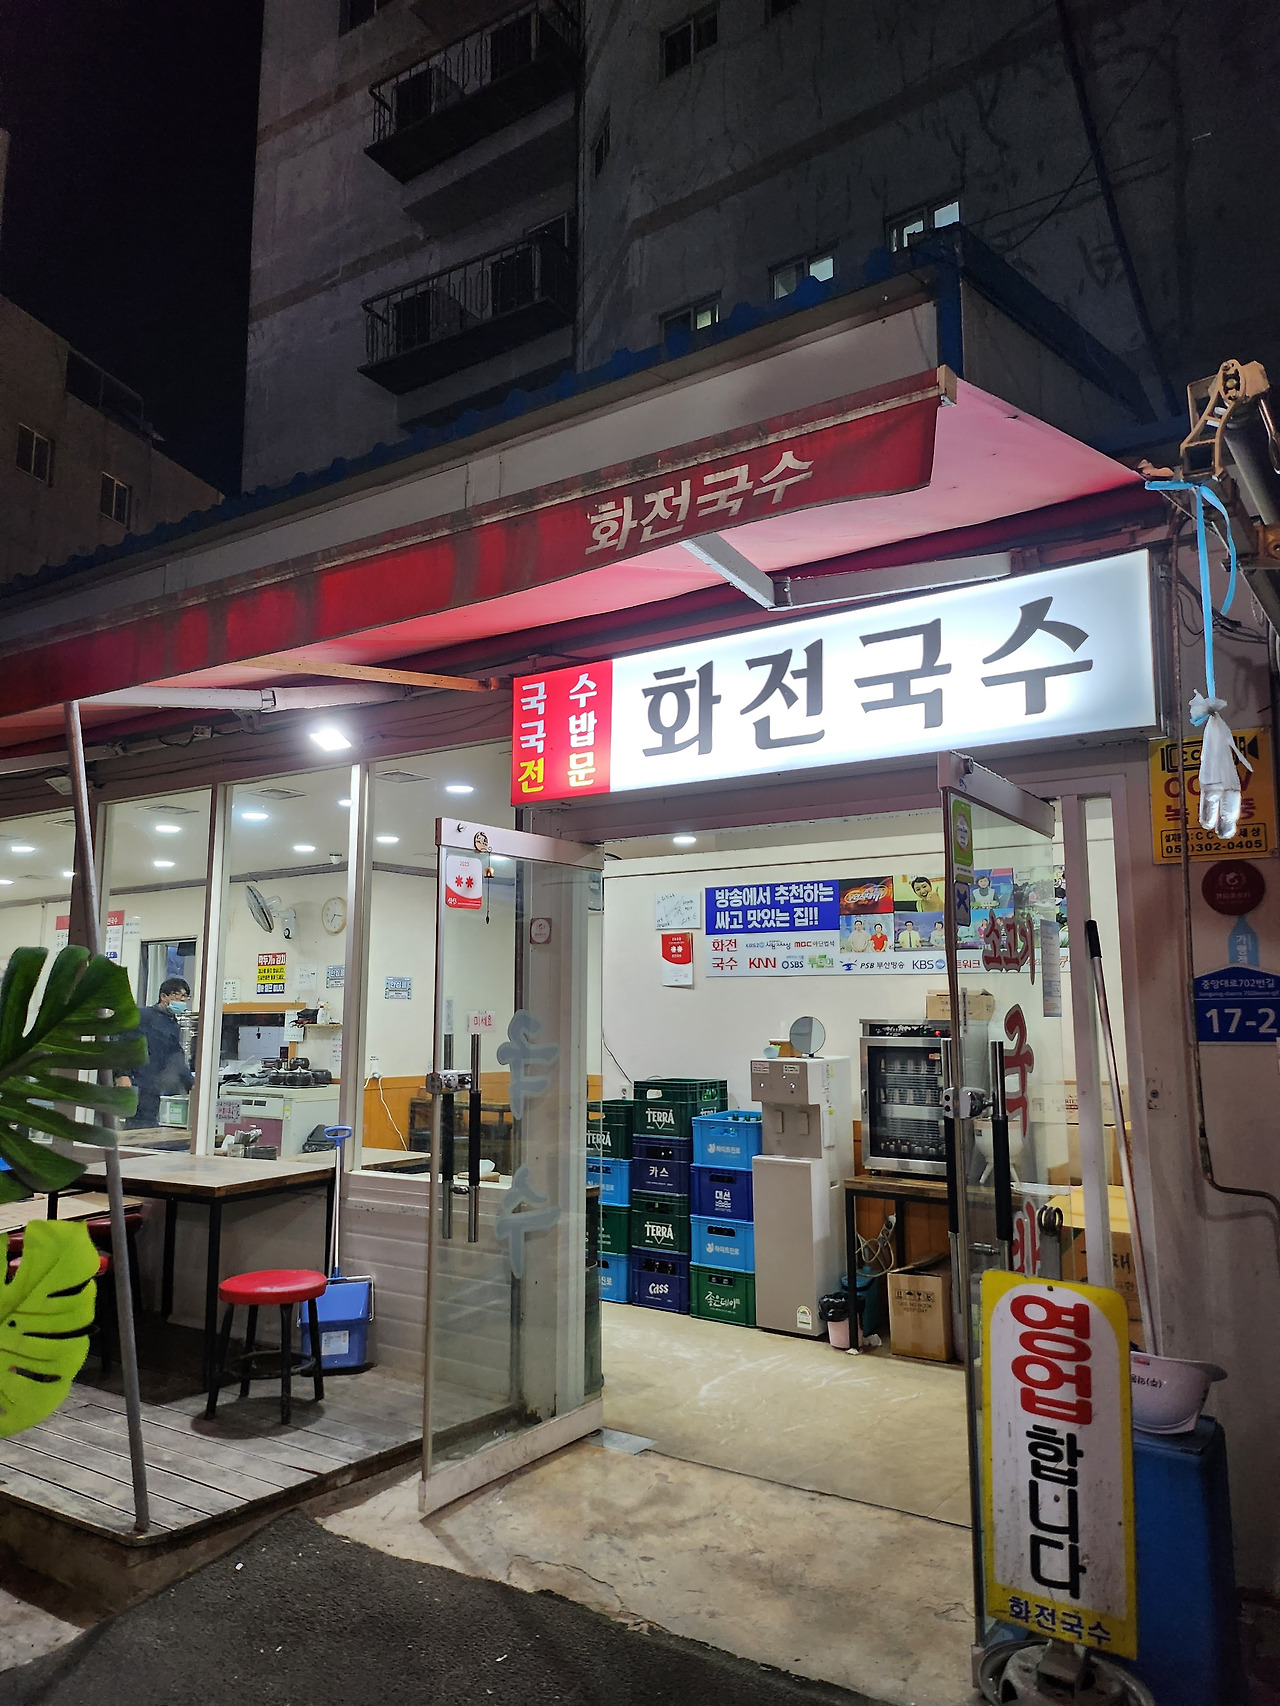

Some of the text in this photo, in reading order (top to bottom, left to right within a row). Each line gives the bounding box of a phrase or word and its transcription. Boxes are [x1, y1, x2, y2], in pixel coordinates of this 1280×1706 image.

[585, 450, 814, 555] 화전국수
[641, 596, 1094, 758] 화전국수
[1165, 839, 1263, 855] 05)302-0405
[715, 886, 771, 908] 방송에서
[774, 883, 834, 905] 추천하는
[715, 910, 743, 930] 싸고
[746, 908, 790, 929] 맛있는
[793, 907, 819, 927] 집!!
[711, 938, 738, 953] 화전
[982, 910, 1036, 985] 소고기
[711, 956, 738, 971] 국수
[748, 957, 777, 969] KNN
[790, 960, 804, 969] SBS
[876, 961, 905, 970] 부산방송
[912, 959, 935, 970] KBS
[1201, 978, 1275, 990] 중앙대로702번길
[1205, 1008, 1278, 1034] 17-2
[646, 1107, 675, 1125] TERRA
[586, 1131, 612, 1147] TERRA
[649, 1166, 669, 1178] 카스
[715, 1189, 732, 1201] 대선
[644, 1221, 674, 1240] TERRA
[648, 1283, 669, 1295] Cass
[705, 1291, 737, 1310] 좋은데이
[1010, 1294, 1093, 1600] 영업합니다
[1009, 1595, 1112, 1646] 화전국수
